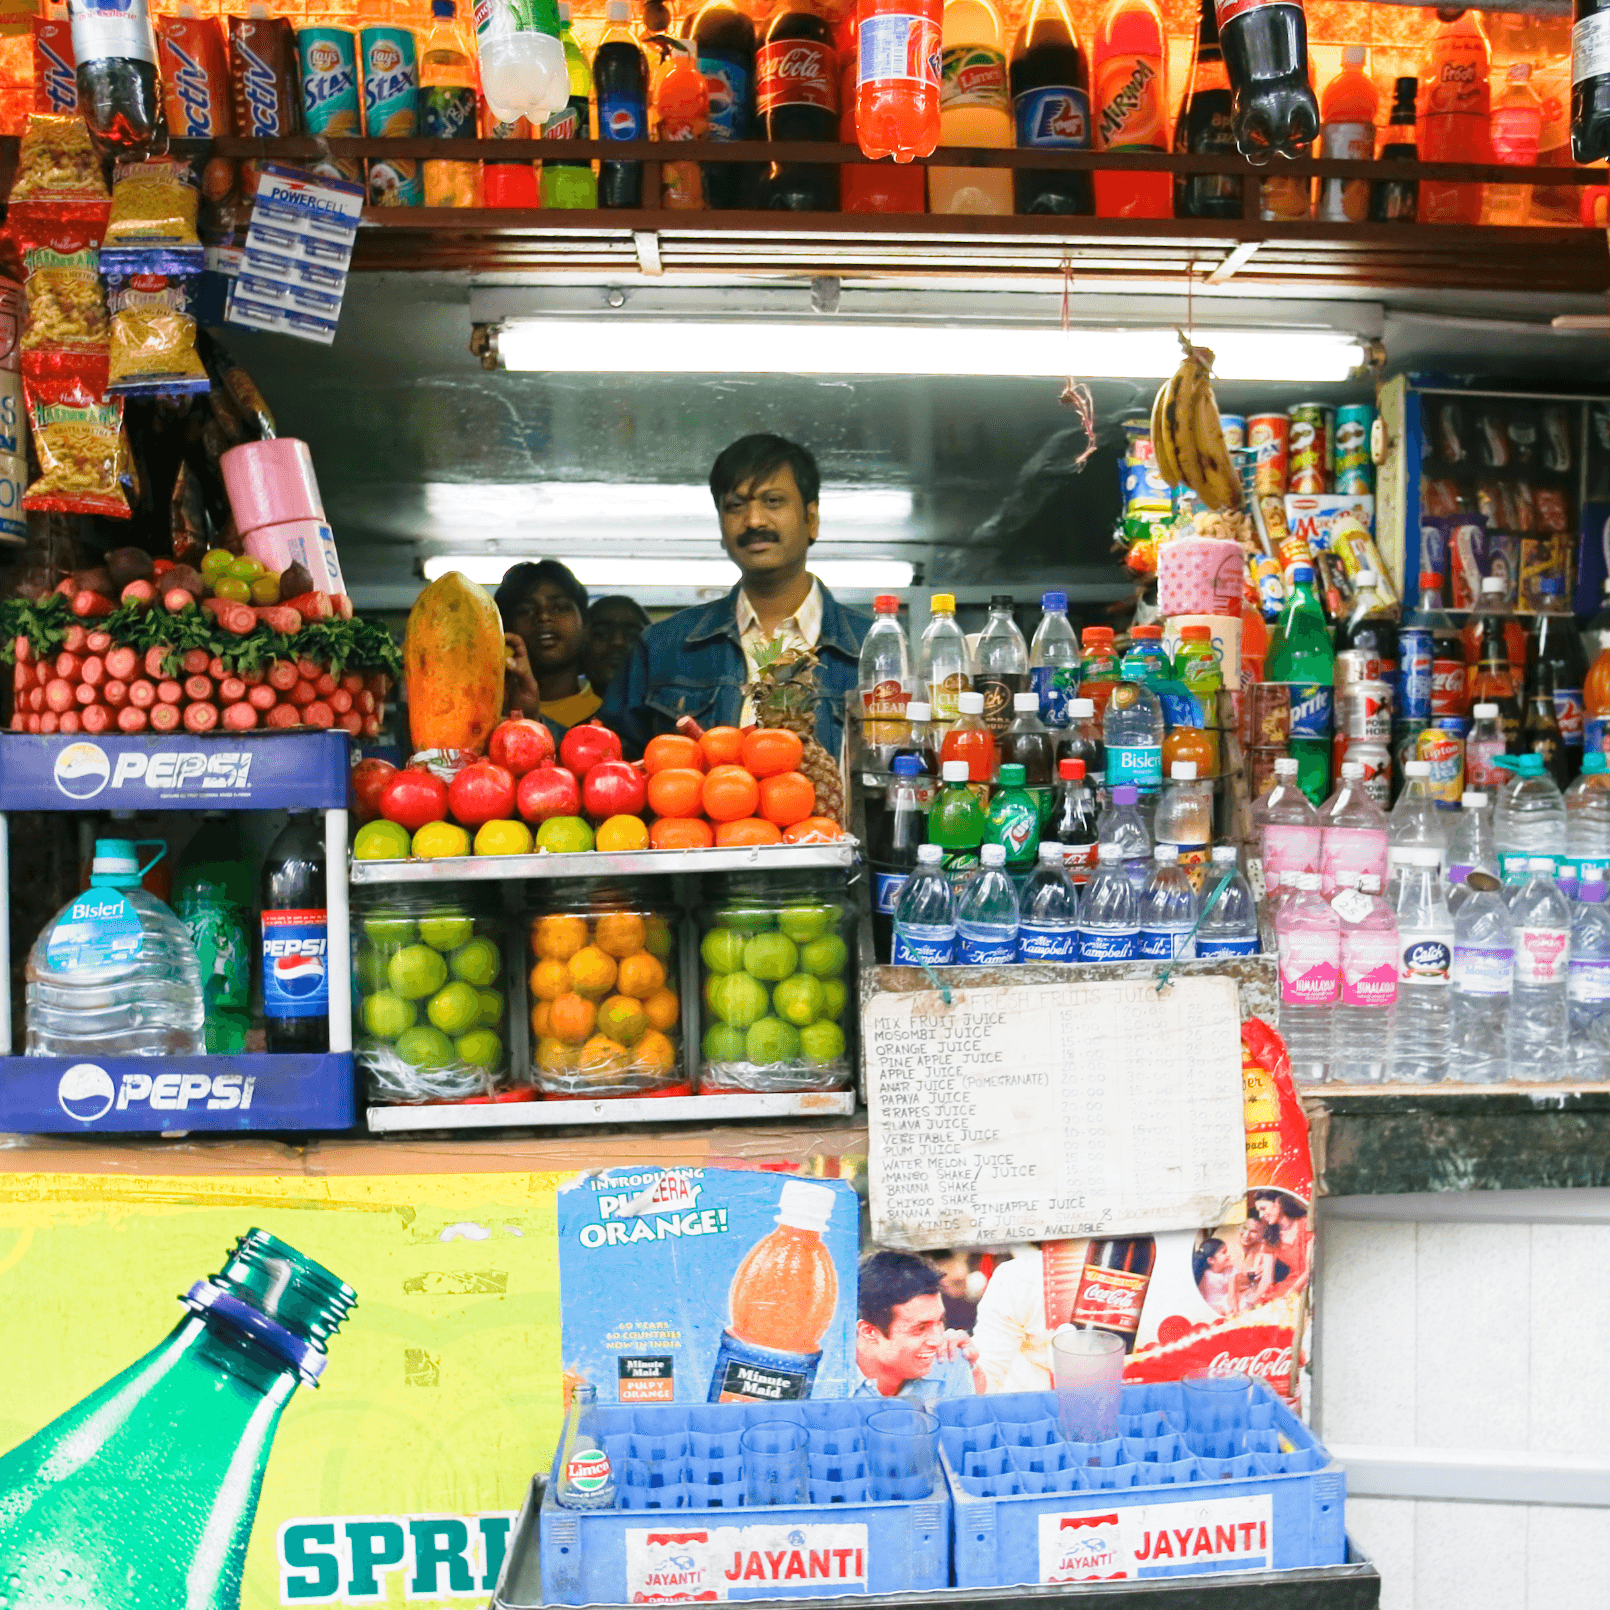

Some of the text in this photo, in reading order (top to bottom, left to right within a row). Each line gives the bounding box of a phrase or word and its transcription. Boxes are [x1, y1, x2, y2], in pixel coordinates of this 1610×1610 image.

[270, 186, 346, 214] POWERCELL
[1290, 690, 1329, 728] prite
[72, 900, 125, 919] Bisleri
[1339, 901, 1358, 916] 25
[263, 939, 327, 957] PEPSI
[1412, 944, 1445, 963] Catch
[874, 1017, 901, 1030] MIX
[909, 1014, 956, 1028] FRUIT
[963, 1012, 1007, 1026] JUICE
[874, 1028, 937, 1042] MOSOMBI
[943, 1026, 992, 1040] JUICE
[875, 1043, 928, 1056] ORANGE
[937, 1040, 982, 1054] JUICE
[962, 1051, 1003, 1064] JUICE
[879, 1068, 916, 1081] APPLE
[924, 1065, 964, 1079] JUICE
[879, 1081, 911, 1093] ANAR
[915, 1078, 956, 1092] JUICE
[962, 1071, 1050, 1089] (POMEGRANATE)
[116, 1073, 257, 1110] PEPSI
[879, 1093, 921, 1106] PAPAYA
[928, 1091, 972, 1104] JUICE
[881, 1105, 931, 1119] GRAPES
[934, 1104, 977, 1117] JUICE
[926, 1117, 970, 1130] JUICE
[959, 1129, 1001, 1142] JUICE
[883, 1145, 913, 1157] PLUM
[919, 1143, 962, 1156] JUICE
[881, 1158, 923, 1171] WATER
[927, 1156, 968, 1169] MELON
[973, 1154, 1015, 1167] JUICE
[991, 1164, 1038, 1179] JUICE
[590, 1168, 704, 1192] INTRODUNG
[885, 1182, 931, 1197] BANANA
[938, 1180, 978, 1193] SHAKE
[886, 1197, 935, 1210] CHIKOO
[940, 1193, 979, 1206] SHAKE
[886, 1208, 931, 1221] BANANA
[971, 1200, 1040, 1215] PINEAPPLE
[1048, 1197, 1086, 1210] JUICE
[579, 1207, 729, 1250] ORANGE!
[970, 1216, 984, 1229] OF
[976, 1221, 1104, 1241] ARE ALSO AVAILABLE
[619, 1321, 670, 1331] 60 YEARS
[606, 1331, 682, 1340] 60 COUNTRIES
[606, 1340, 683, 1350] NOW IN INDIA
[627, 1359, 665, 1369] Minute
[632, 1367, 661, 1377] Maid
[628, 1381, 665, 1391] PULPY
[737, 1367, 792, 1389] Minute
[622, 1389, 670, 1399] ORANGE
[741, 1380, 782, 1399] Maid
[568, 1461, 610, 1477] Limca
[1134, 1520, 1267, 1562] JAYANTI
[724, 1547, 864, 1582] JAYANTI
[1058, 1552, 1113, 1571] JAYANTI
[645, 1571, 702, 1587] JAYANTI
